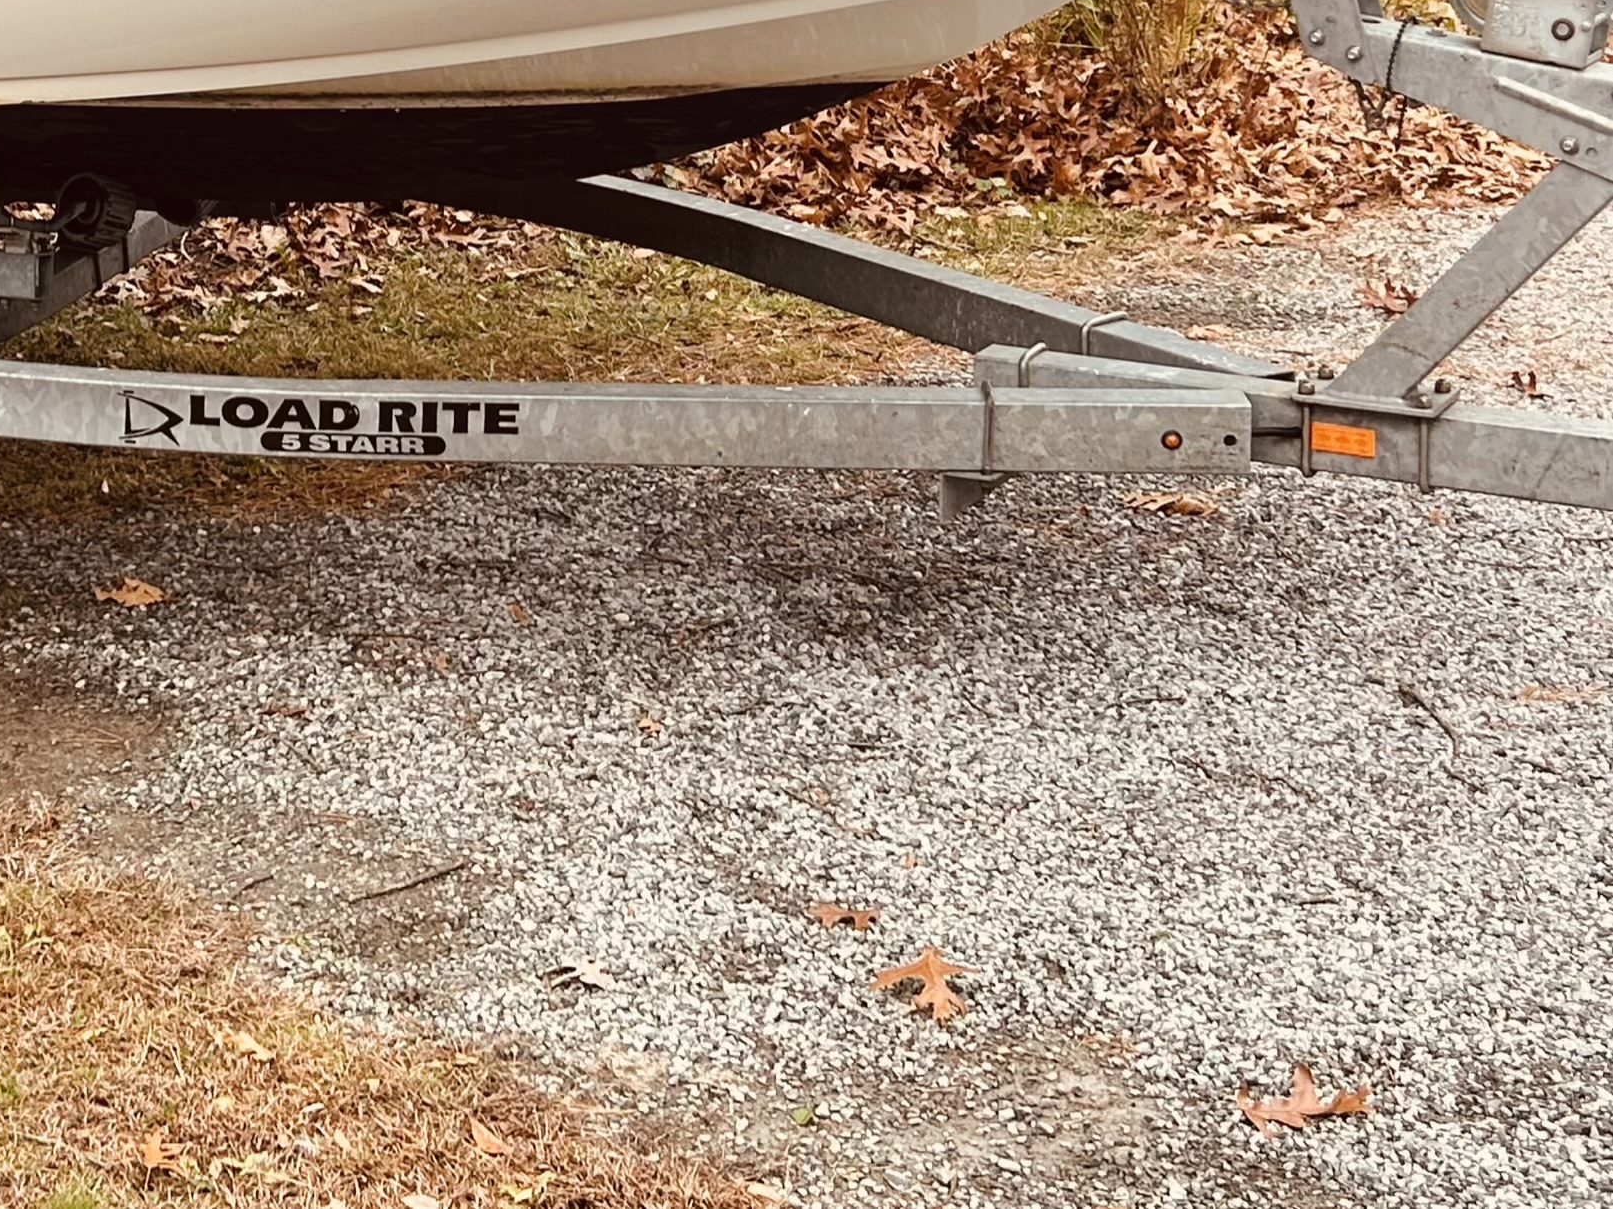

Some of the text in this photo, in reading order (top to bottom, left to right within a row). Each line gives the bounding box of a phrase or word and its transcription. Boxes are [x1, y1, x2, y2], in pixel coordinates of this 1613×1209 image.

[190, 394, 520, 434] LOAD RITE
[281, 433, 425, 454] 5 STARR
